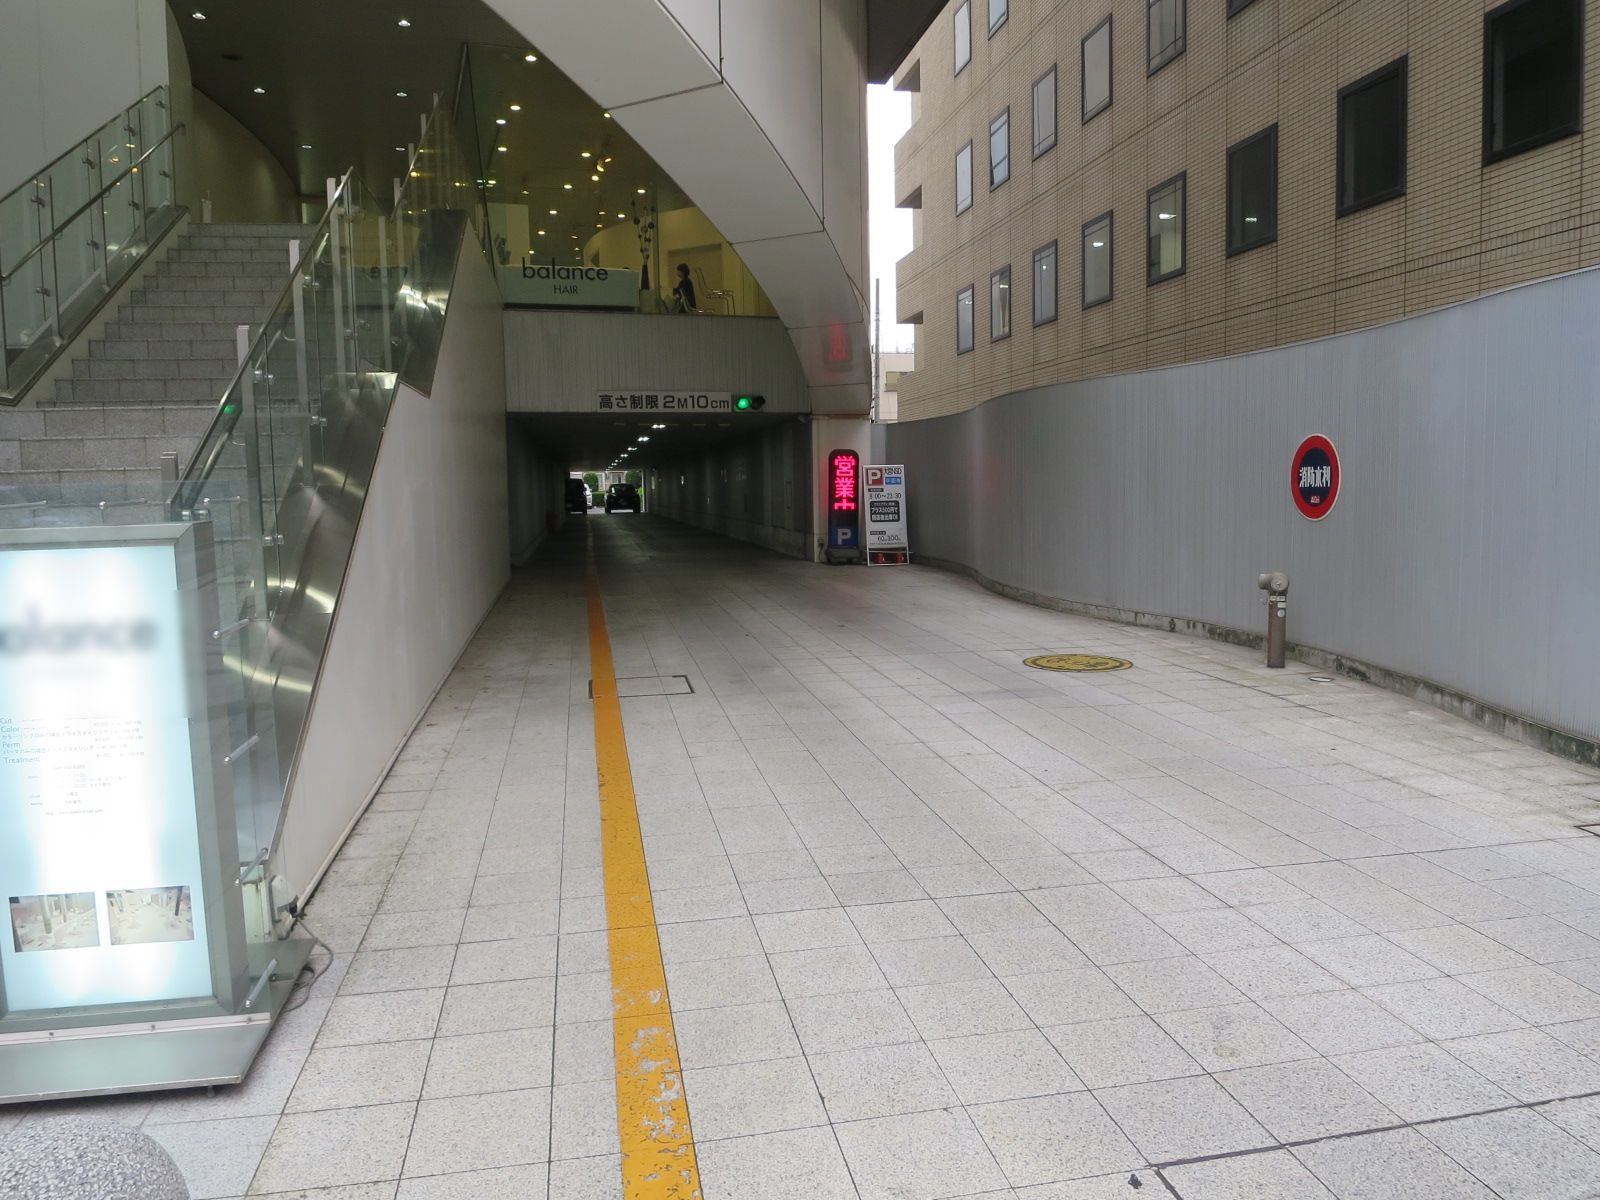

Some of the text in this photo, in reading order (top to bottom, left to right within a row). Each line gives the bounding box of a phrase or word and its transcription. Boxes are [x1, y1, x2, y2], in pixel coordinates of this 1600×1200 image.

[522, 257, 609, 281] balance
[553, 284, 578, 295] HAIR
[599, 394, 660, 409] 高さ制限
[867, 469, 882, 485] P
[1299, 466, 1331, 488] 消防水利
[837, 528, 852, 545] P
